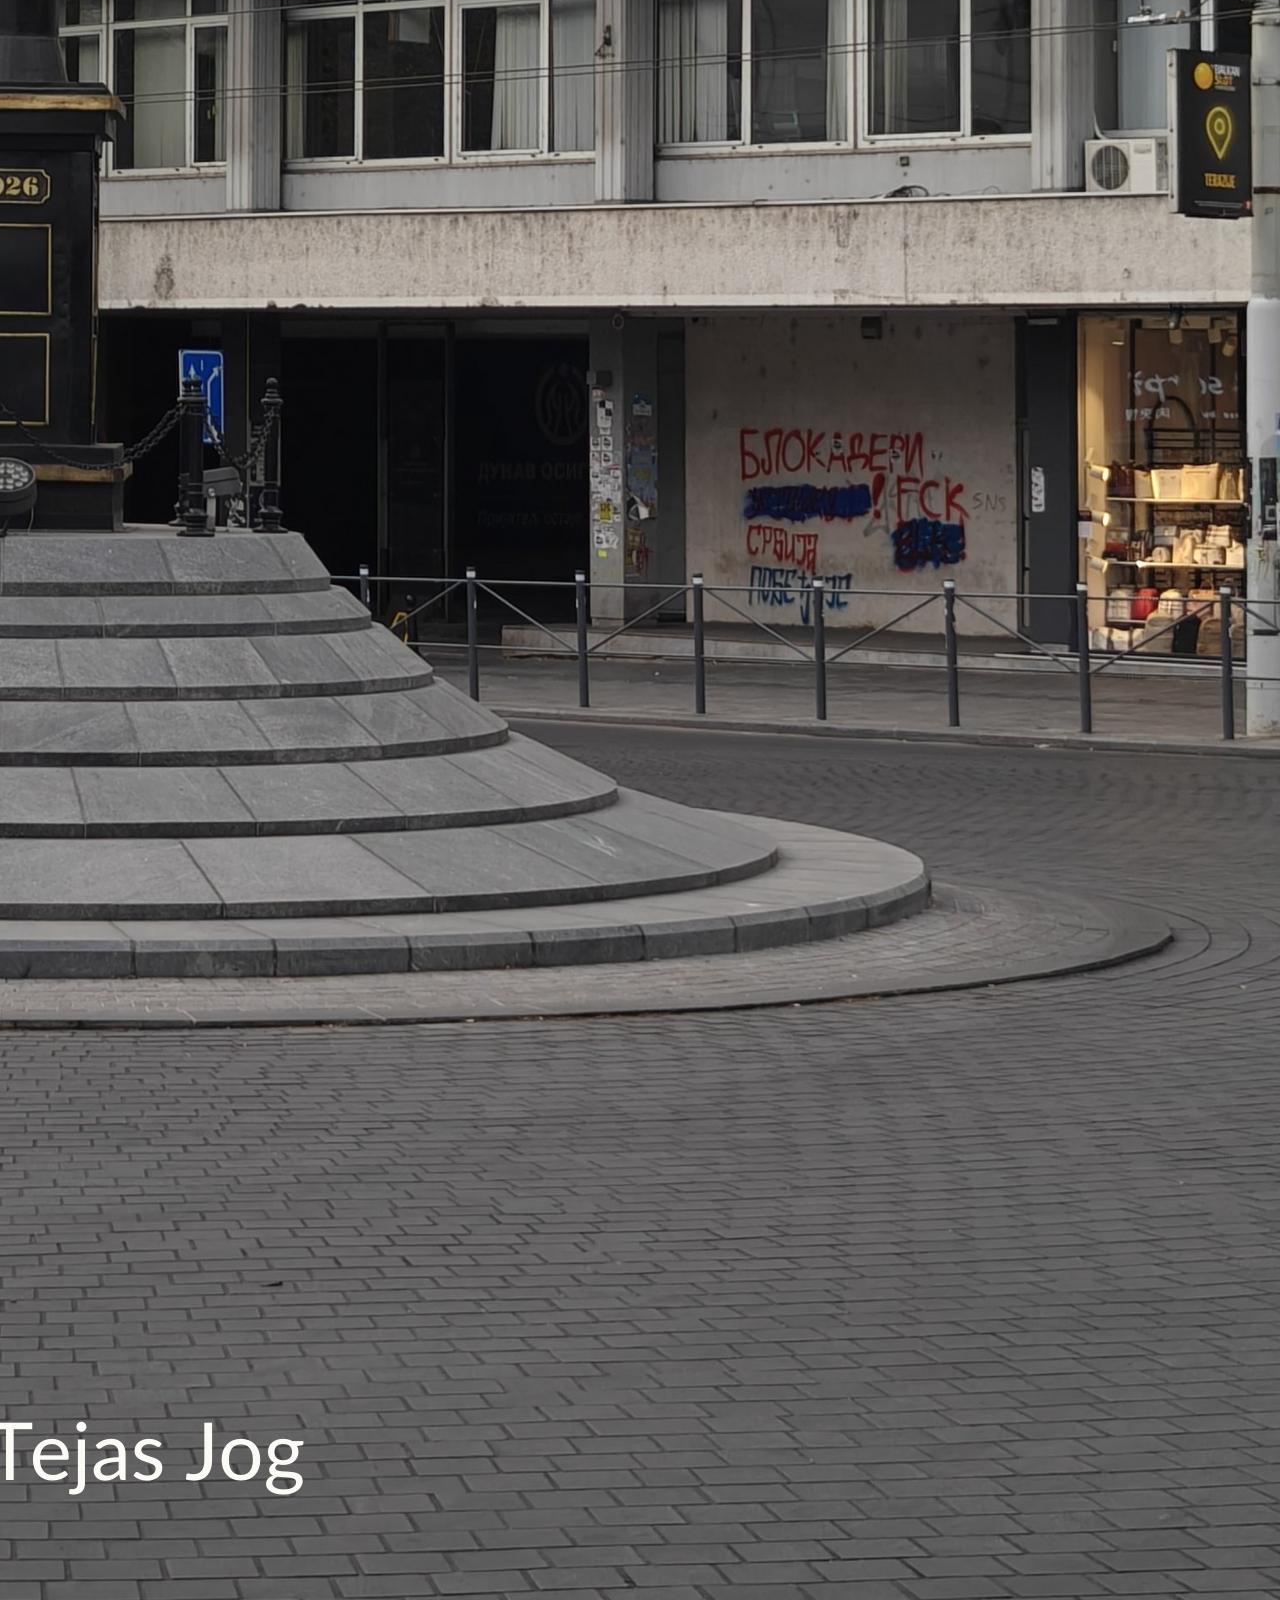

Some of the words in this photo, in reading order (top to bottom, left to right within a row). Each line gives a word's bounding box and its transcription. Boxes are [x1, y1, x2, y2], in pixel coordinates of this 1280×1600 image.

[740, 428, 924, 481] БЛОКАДЕРИ
[477, 461, 536, 485] ДУНАВ
[896, 476, 969, 522] FCK
[972, 492, 1007, 512] SNS
